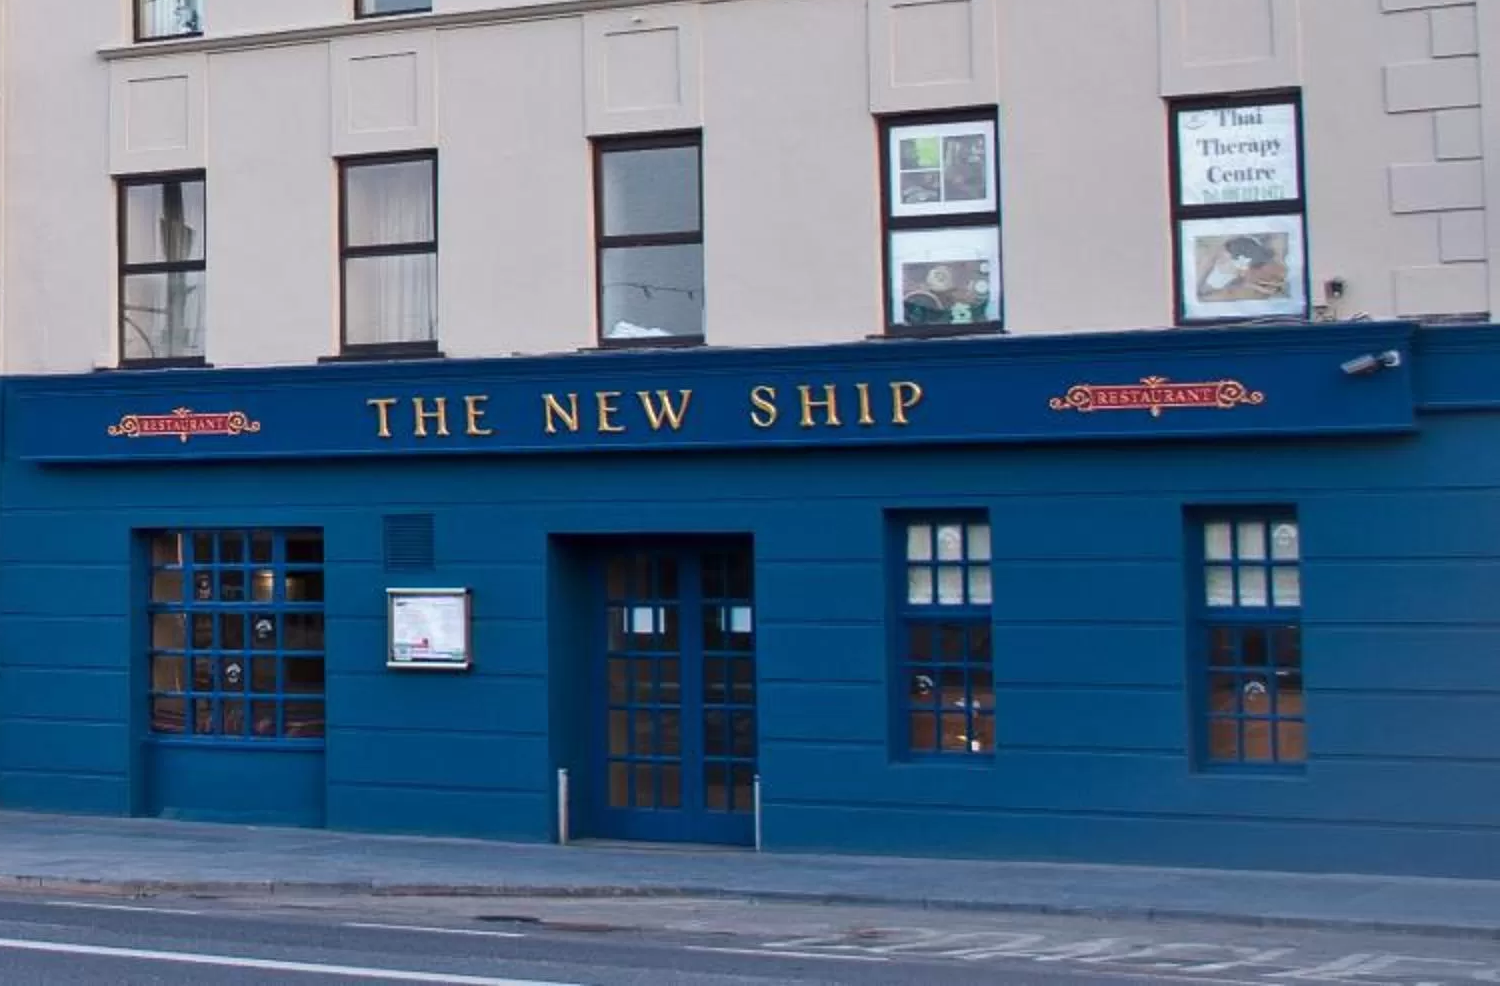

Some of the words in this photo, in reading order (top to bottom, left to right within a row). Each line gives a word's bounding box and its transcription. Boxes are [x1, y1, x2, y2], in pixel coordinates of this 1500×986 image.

[1212, 105, 1264, 127] Thai
[1196, 137, 1281, 157] Therapy
[1206, 165, 1276, 183] Centre
[1093, 388, 1212, 405] RESTAURANT
[366, 394, 493, 438] THE
[541, 389, 693, 434] NEW
[750, 381, 924, 428] SHIP
[141, 417, 224, 432] RESTAURANT
